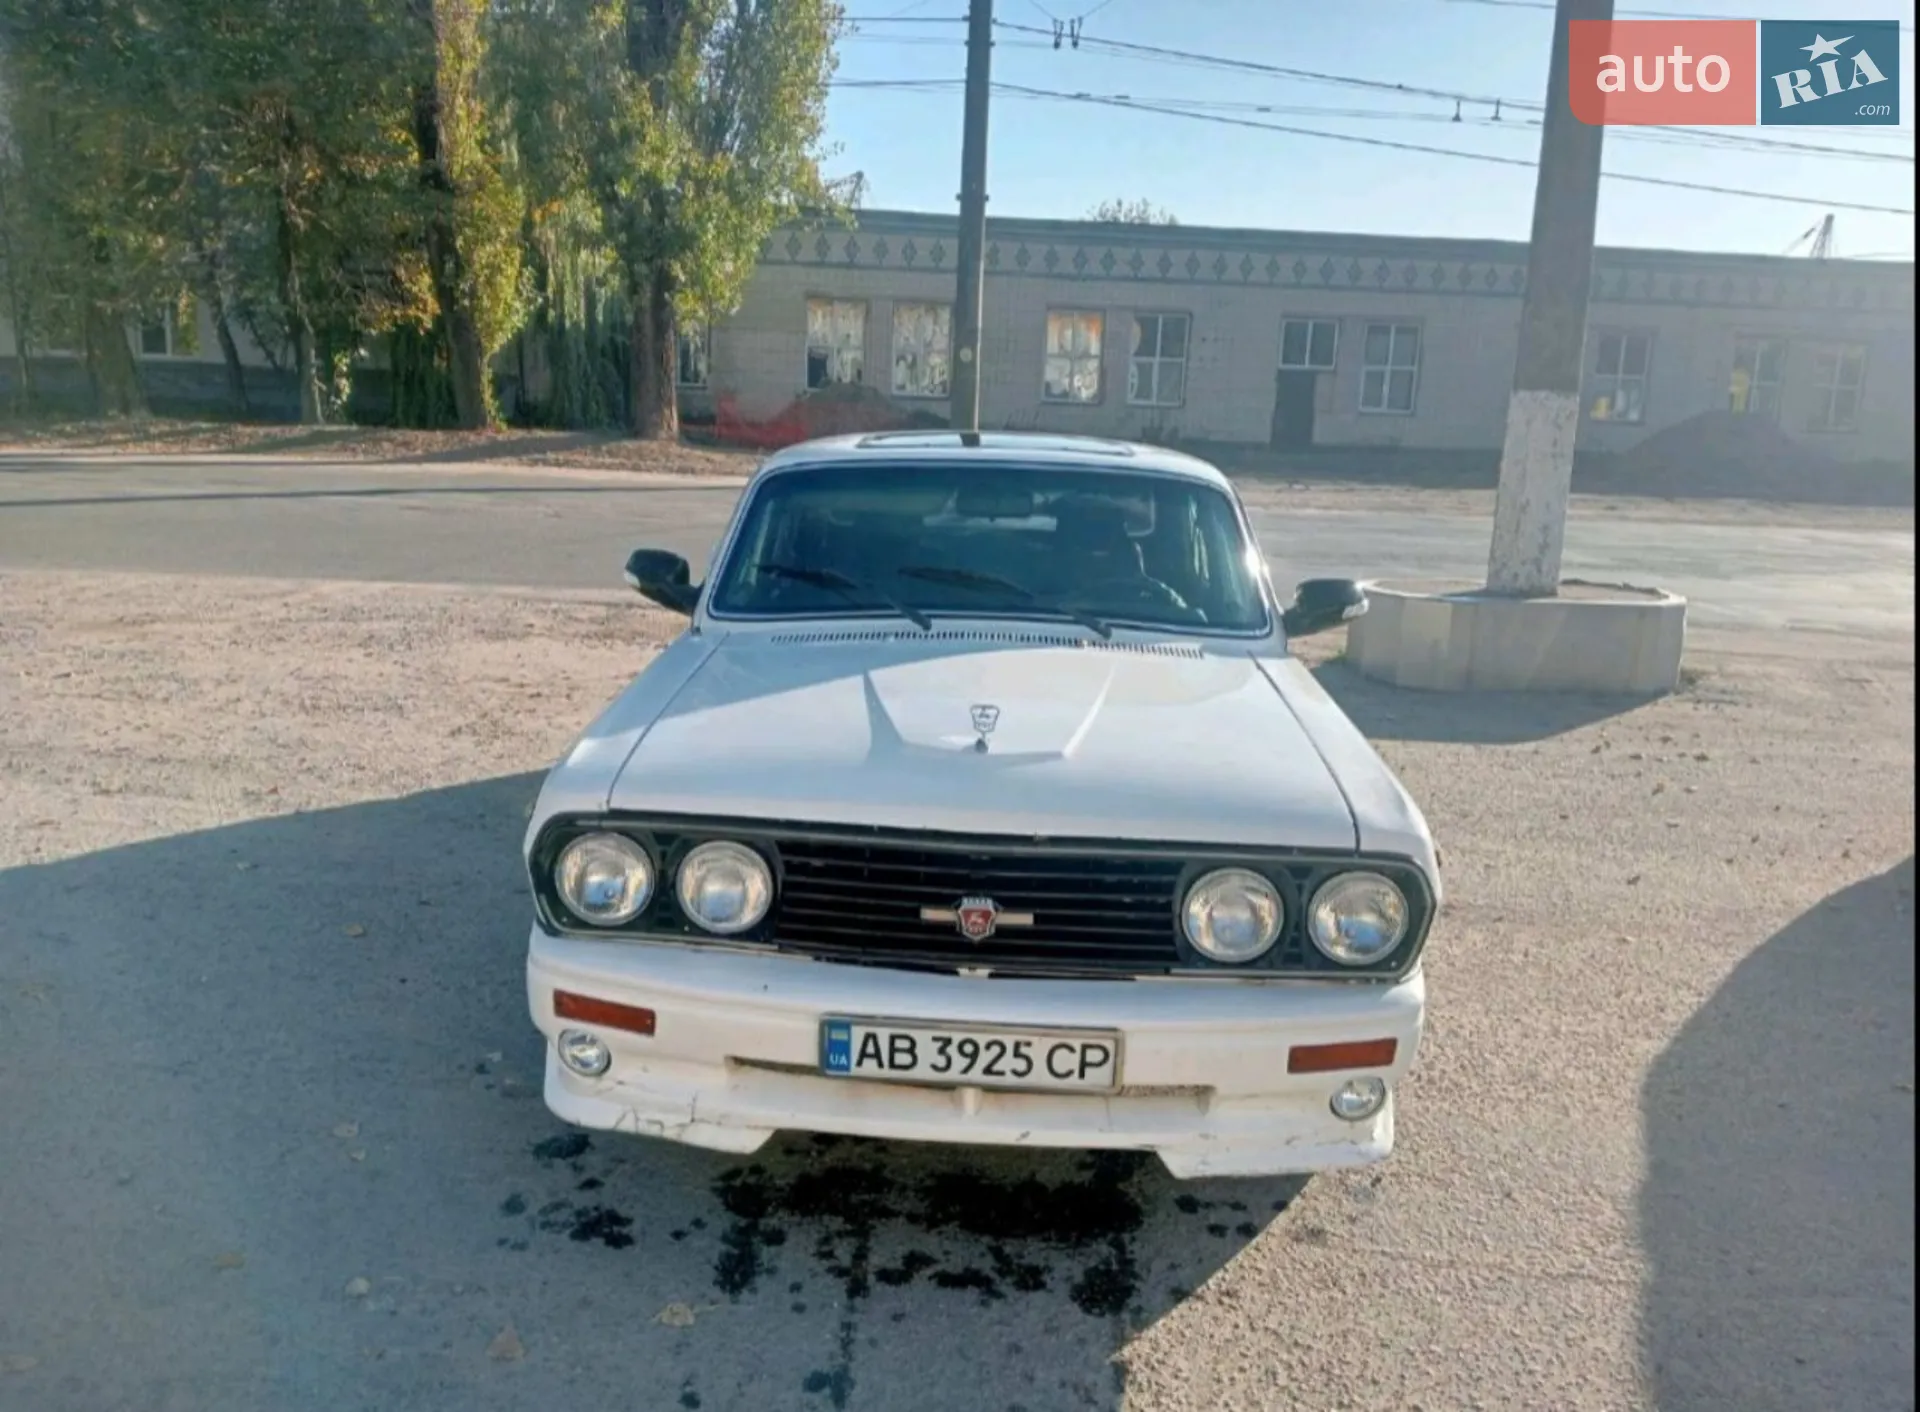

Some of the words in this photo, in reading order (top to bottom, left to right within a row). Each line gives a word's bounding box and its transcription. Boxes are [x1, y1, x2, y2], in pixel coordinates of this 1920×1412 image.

[829, 1055, 848, 1066] UA
[855, 1031, 919, 1071] AB
[929, 1036, 1034, 1078] 3925
[1046, 1043, 1111, 1080] CP
